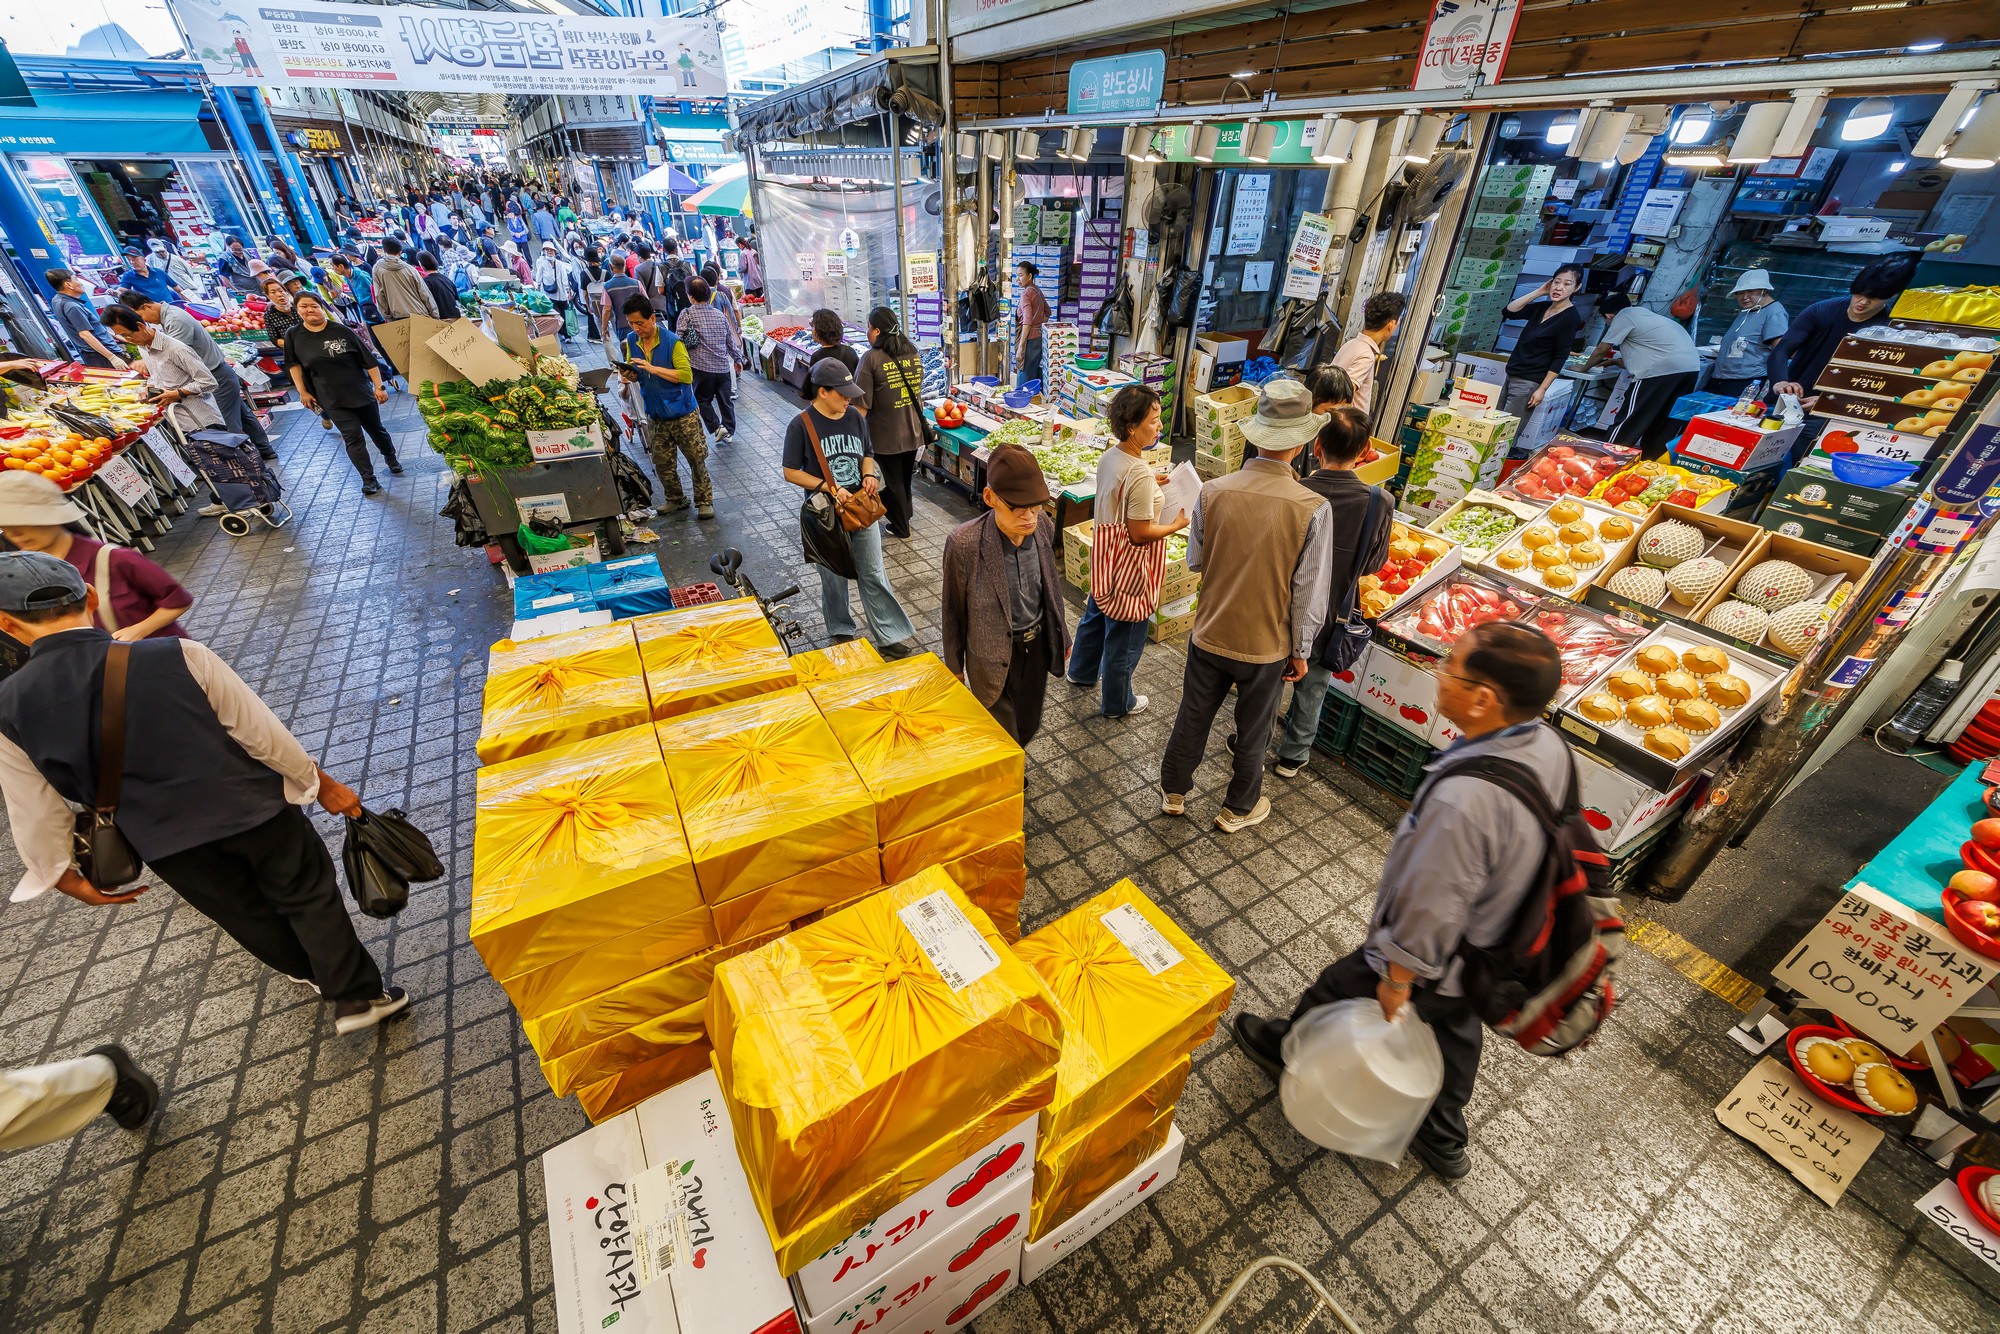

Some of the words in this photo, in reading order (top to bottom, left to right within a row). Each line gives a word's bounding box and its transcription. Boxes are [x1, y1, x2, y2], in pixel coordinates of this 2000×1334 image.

[1424, 47, 1460, 67] CCTV
[1460, 42, 1502, 65] 작동중
[1102, 67, 1154, 97] 한도상사
[1300, 230, 1327, 247] 환급행사
[1295, 242, 1322, 260] 참여점포
[911, 266, 934, 276] 환급행사
[911, 275, 934, 285] 참여점포
[1461, 392, 1487, 405] Supreme
[541, 443, 571, 454] 시금치
[1876, 446, 1912, 462] 사과
[1933, 526, 1961, 537] 제로페이
[1367, 686, 1397, 707] 사과
[1838, 896, 1870, 924] 햇
[1870, 911, 1909, 943] 홍로
[594, 1182, 643, 1313] 단양사과
[832, 1208, 936, 1283] 사과
[850, 1275, 938, 1334] 사과
